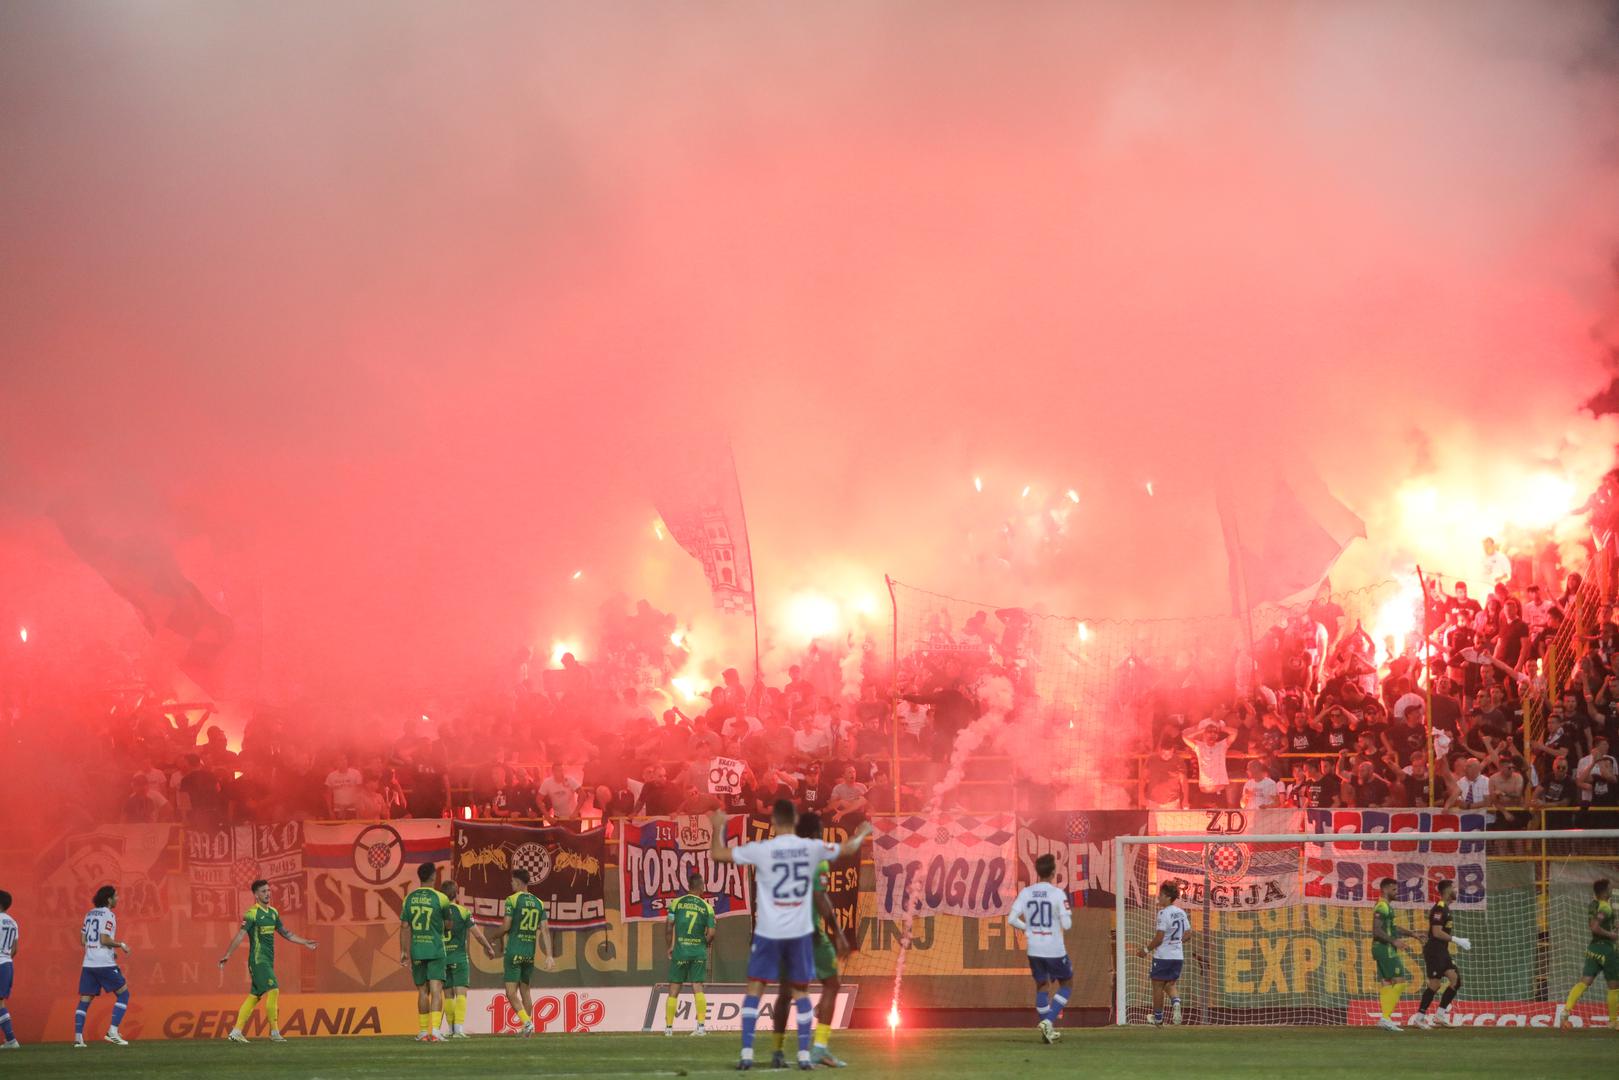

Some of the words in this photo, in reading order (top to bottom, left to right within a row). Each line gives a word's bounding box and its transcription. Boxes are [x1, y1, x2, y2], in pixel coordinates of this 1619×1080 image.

[1205, 810, 1244, 834] ZD
[1306, 809, 1485, 853] TORCIDA
[627, 836, 743, 903] TORCIDA
[772, 862, 810, 898] 25
[1304, 857, 1486, 903] ZAGREB
[410, 906, 433, 930] 27
[455, 887, 604, 921] toida
[519, 908, 540, 931] 20
[1027, 900, 1052, 928] 20
[685, 910, 698, 935] 7
[1170, 919, 1185, 941] 21
[1224, 936, 1455, 994] EXPRES
